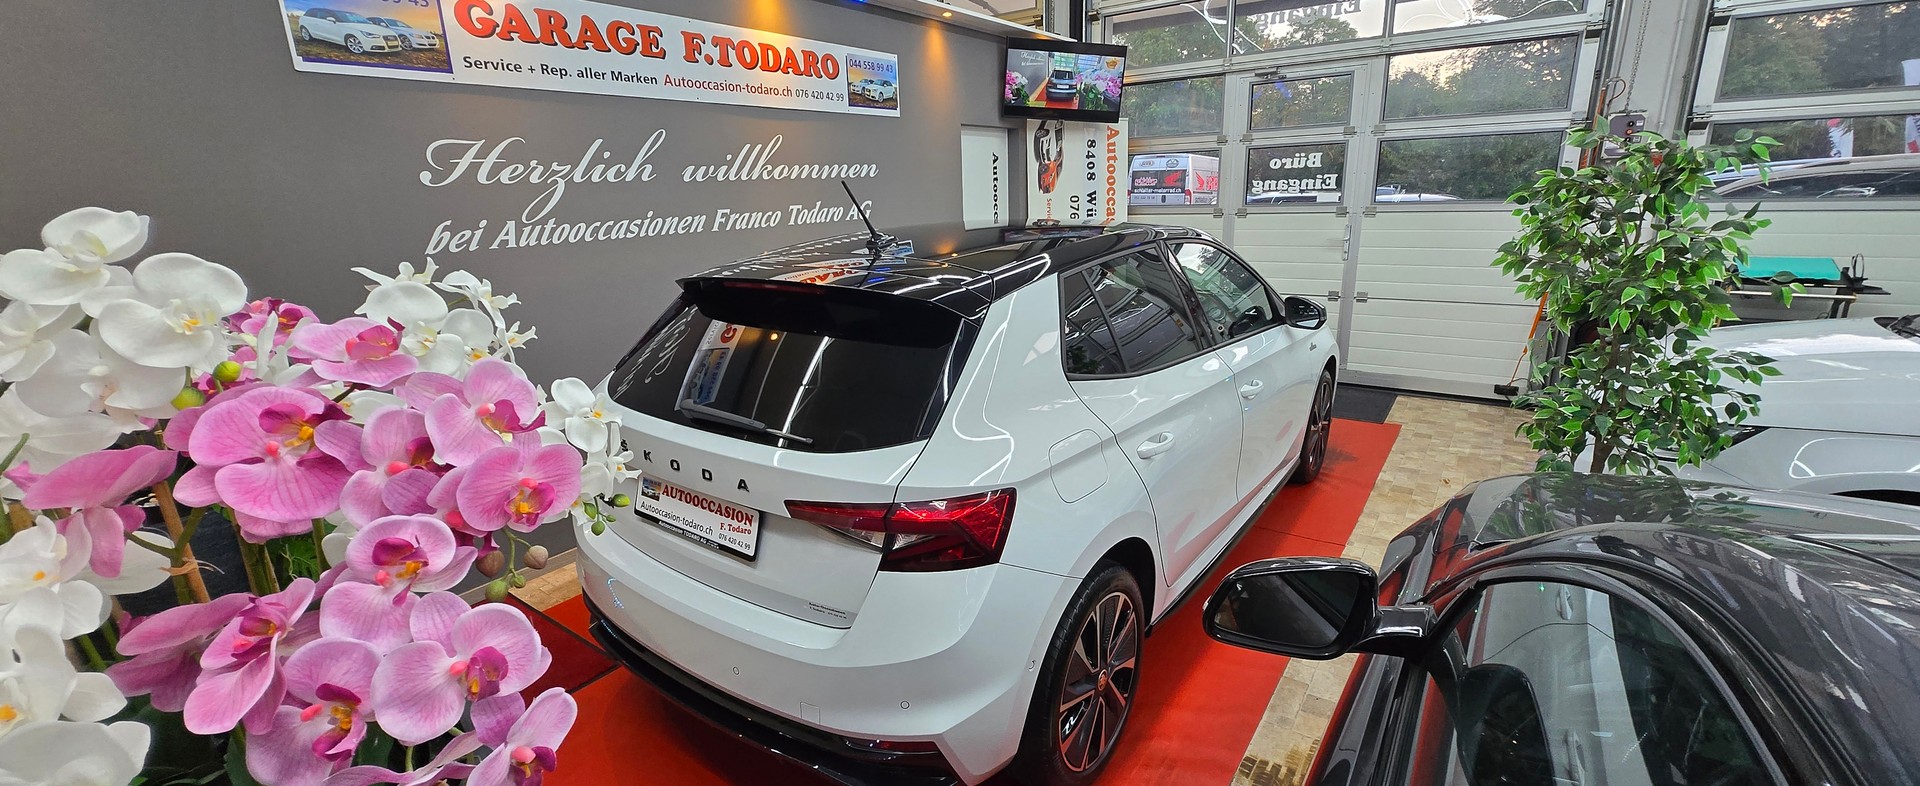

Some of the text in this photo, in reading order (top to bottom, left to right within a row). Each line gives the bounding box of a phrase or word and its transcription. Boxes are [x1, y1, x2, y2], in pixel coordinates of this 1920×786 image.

[453, 0, 840, 80] GARAGE F.TODARO
[462, 55, 845, 102] Service + Rep. aller Marken Autooccasion-todaro.ch 076 420 42 99
[849, 58, 894, 73] 044 558 99 43
[419, 128, 879, 224] Herzlich willkommen
[1085, 138, 1097, 219] 8408 Wü
[424, 200, 873, 255] bei Autooccasionen Franco Todaro AG
[1069, 195, 1080, 220] 076
[640, 500, 714, 537] Autooccasion-todaro.ch
[661, 484, 755, 528] AUTOOCCASION
[719, 521, 752, 535] F. Todaro
[718, 532, 751, 551] 076 420 42 99
